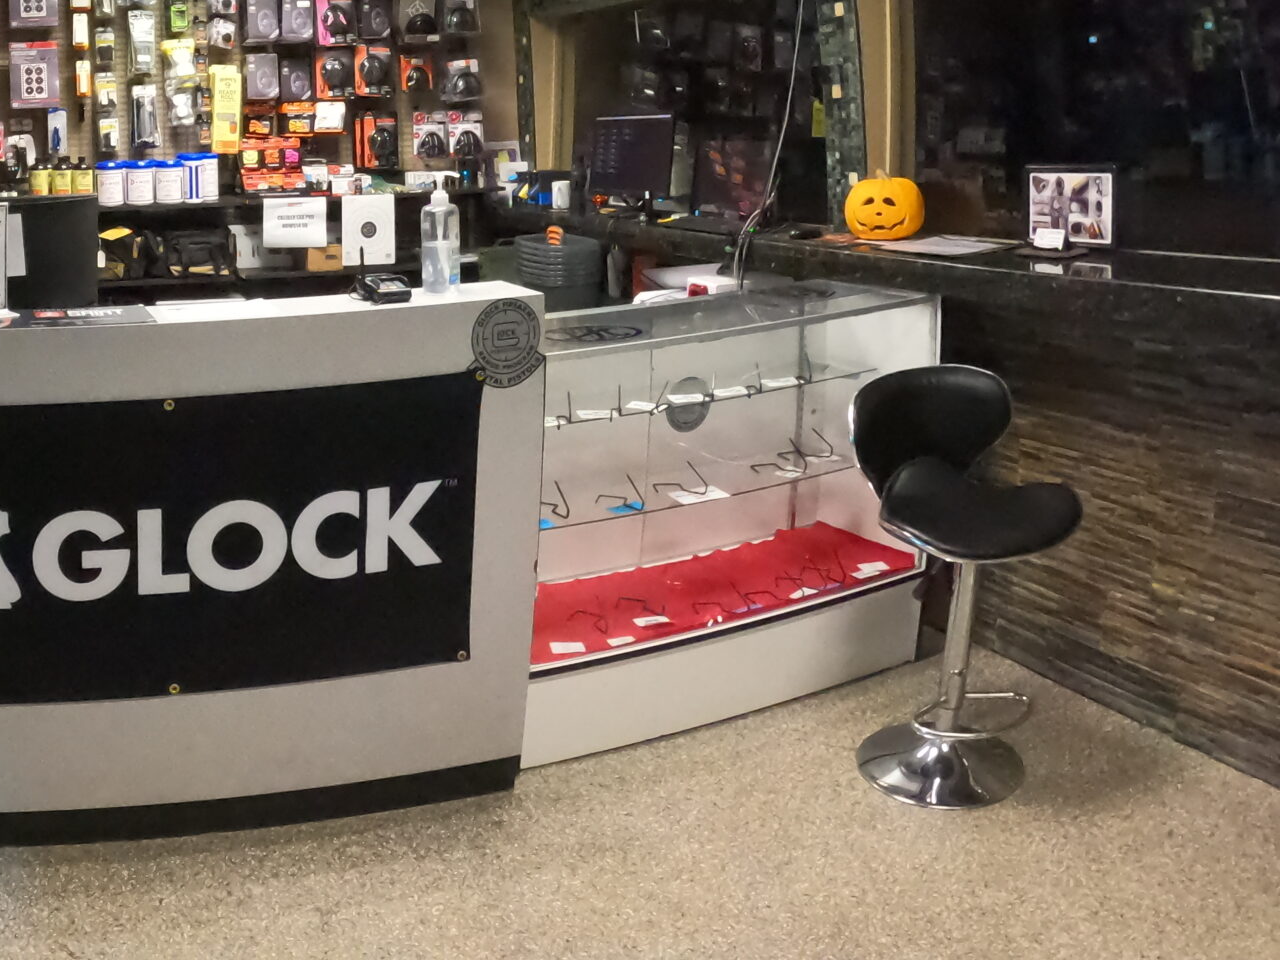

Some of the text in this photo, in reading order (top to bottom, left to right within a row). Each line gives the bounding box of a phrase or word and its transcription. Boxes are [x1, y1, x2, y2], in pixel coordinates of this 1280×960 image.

[477, 301, 536, 328] GLOCK FIREARMS
[32, 478, 443, 602] GLOCK
